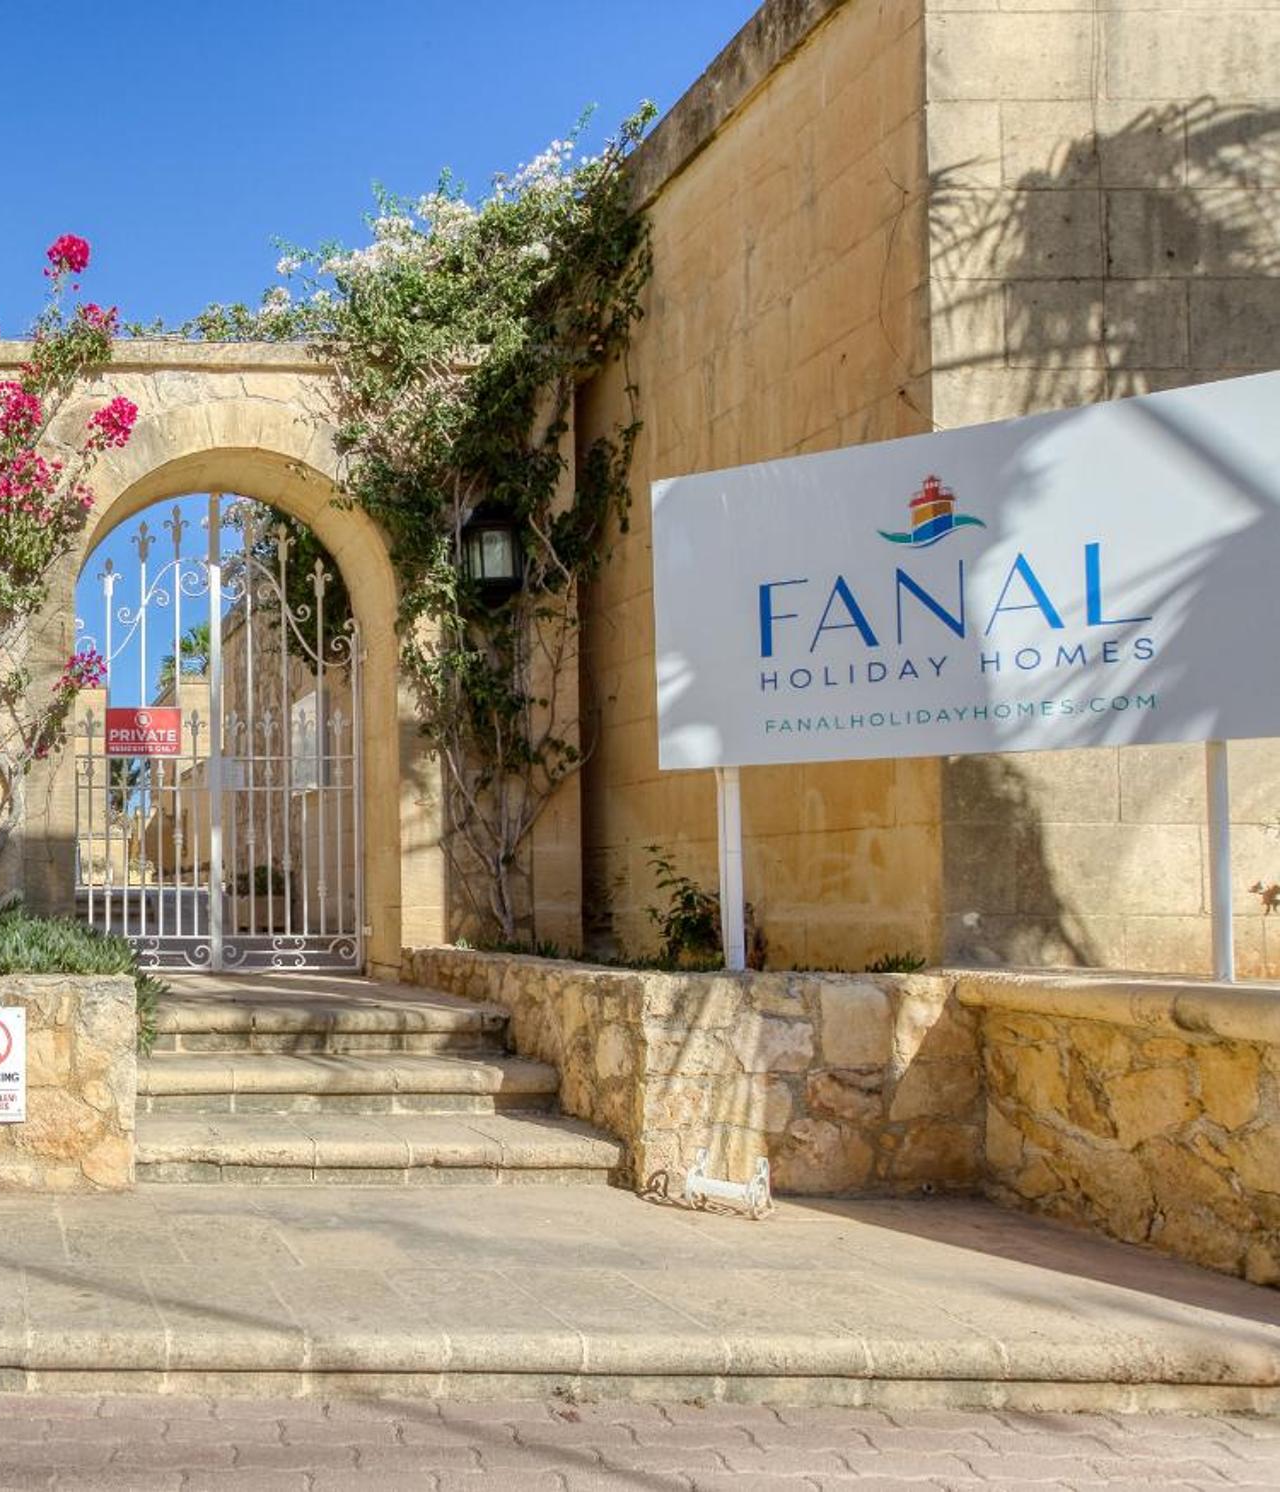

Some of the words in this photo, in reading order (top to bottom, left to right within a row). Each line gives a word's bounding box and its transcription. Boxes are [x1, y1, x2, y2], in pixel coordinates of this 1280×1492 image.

[759, 542, 1153, 658] FANAL
[761, 656, 948, 692] HOLIDAY
[980, 637, 1155, 675] HOMES
[764, 694, 1157, 734] FANALHOLIDAYHOMES.COM
[109, 729, 177, 742] PRIVATE
[155, 745, 177, 753] ONLY
